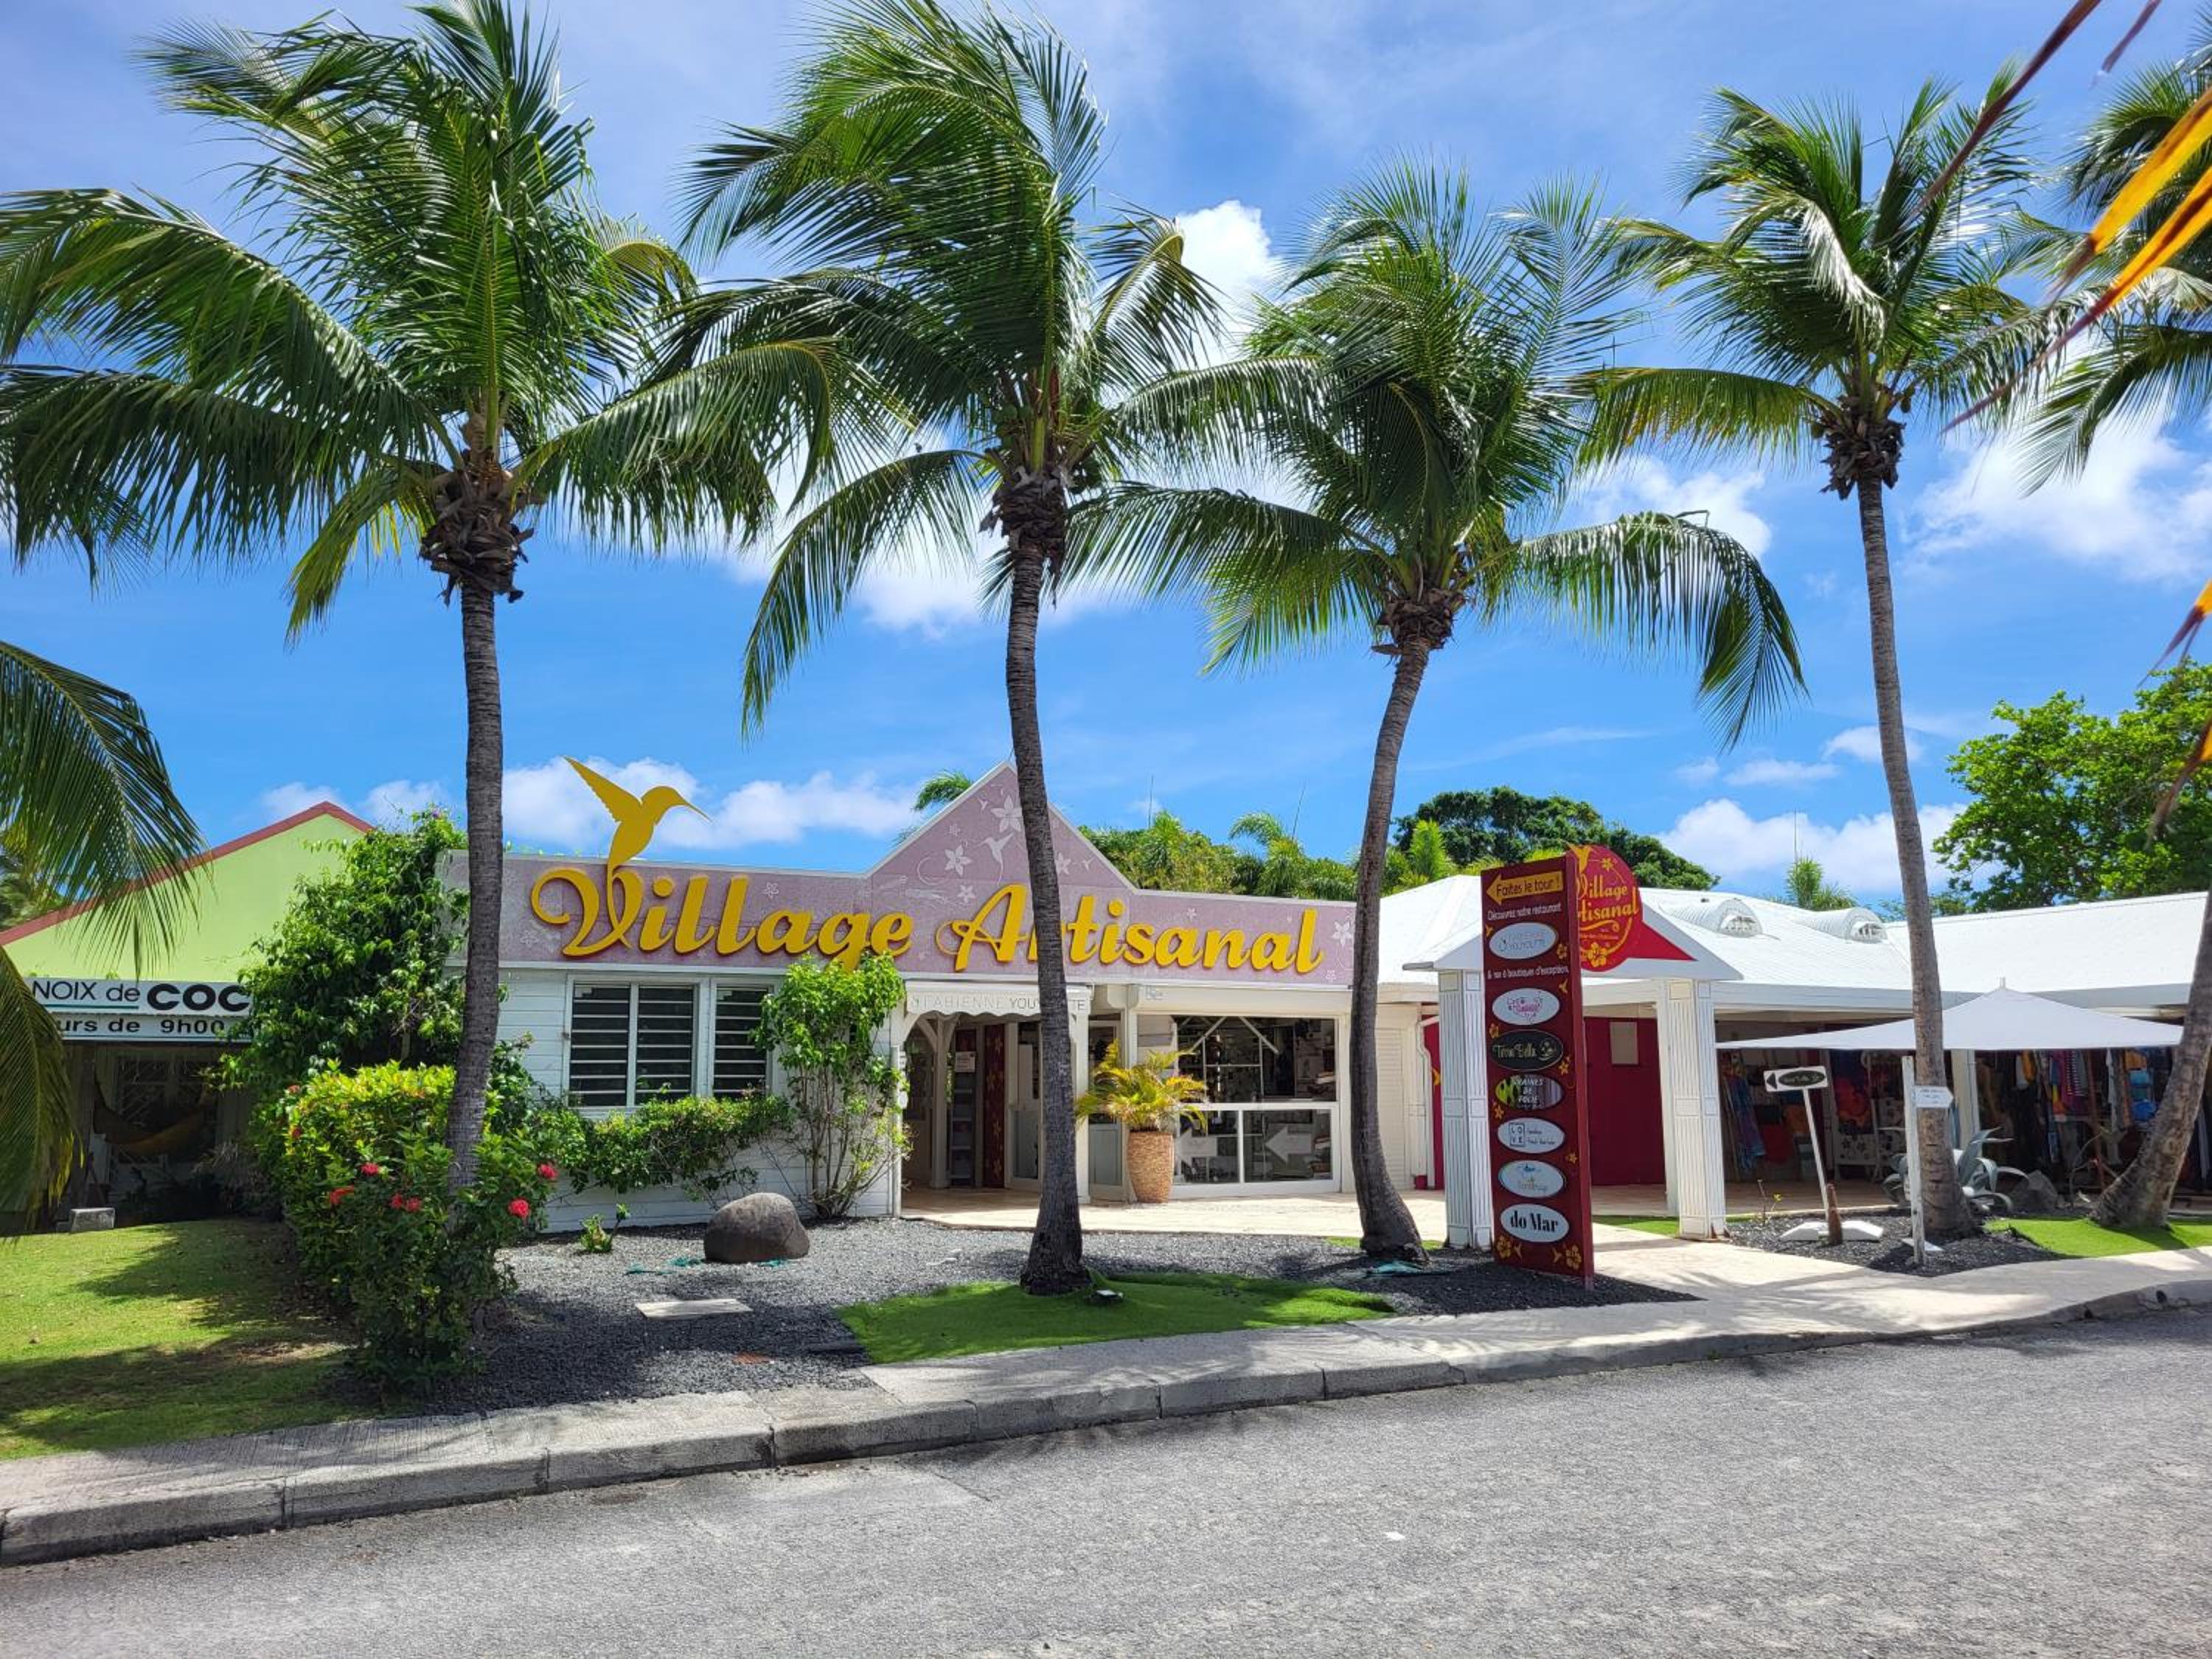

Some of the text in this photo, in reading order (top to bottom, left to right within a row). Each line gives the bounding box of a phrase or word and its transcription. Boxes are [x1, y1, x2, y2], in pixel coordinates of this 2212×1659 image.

[1496, 883, 1523, 897] Faites
[1524, 880, 1533, 891] le
[1535, 878, 1554, 891] tour
[1576, 873, 1628, 900] Village
[1577, 886, 1639, 922] tisanal
[530, 867, 1324, 973] Village Atisanal
[32, 981, 251, 1012] NOIX de COC
[60, 1018, 225, 1034] urs de 9h00
[1510, 1210, 1559, 1233] do Mar
